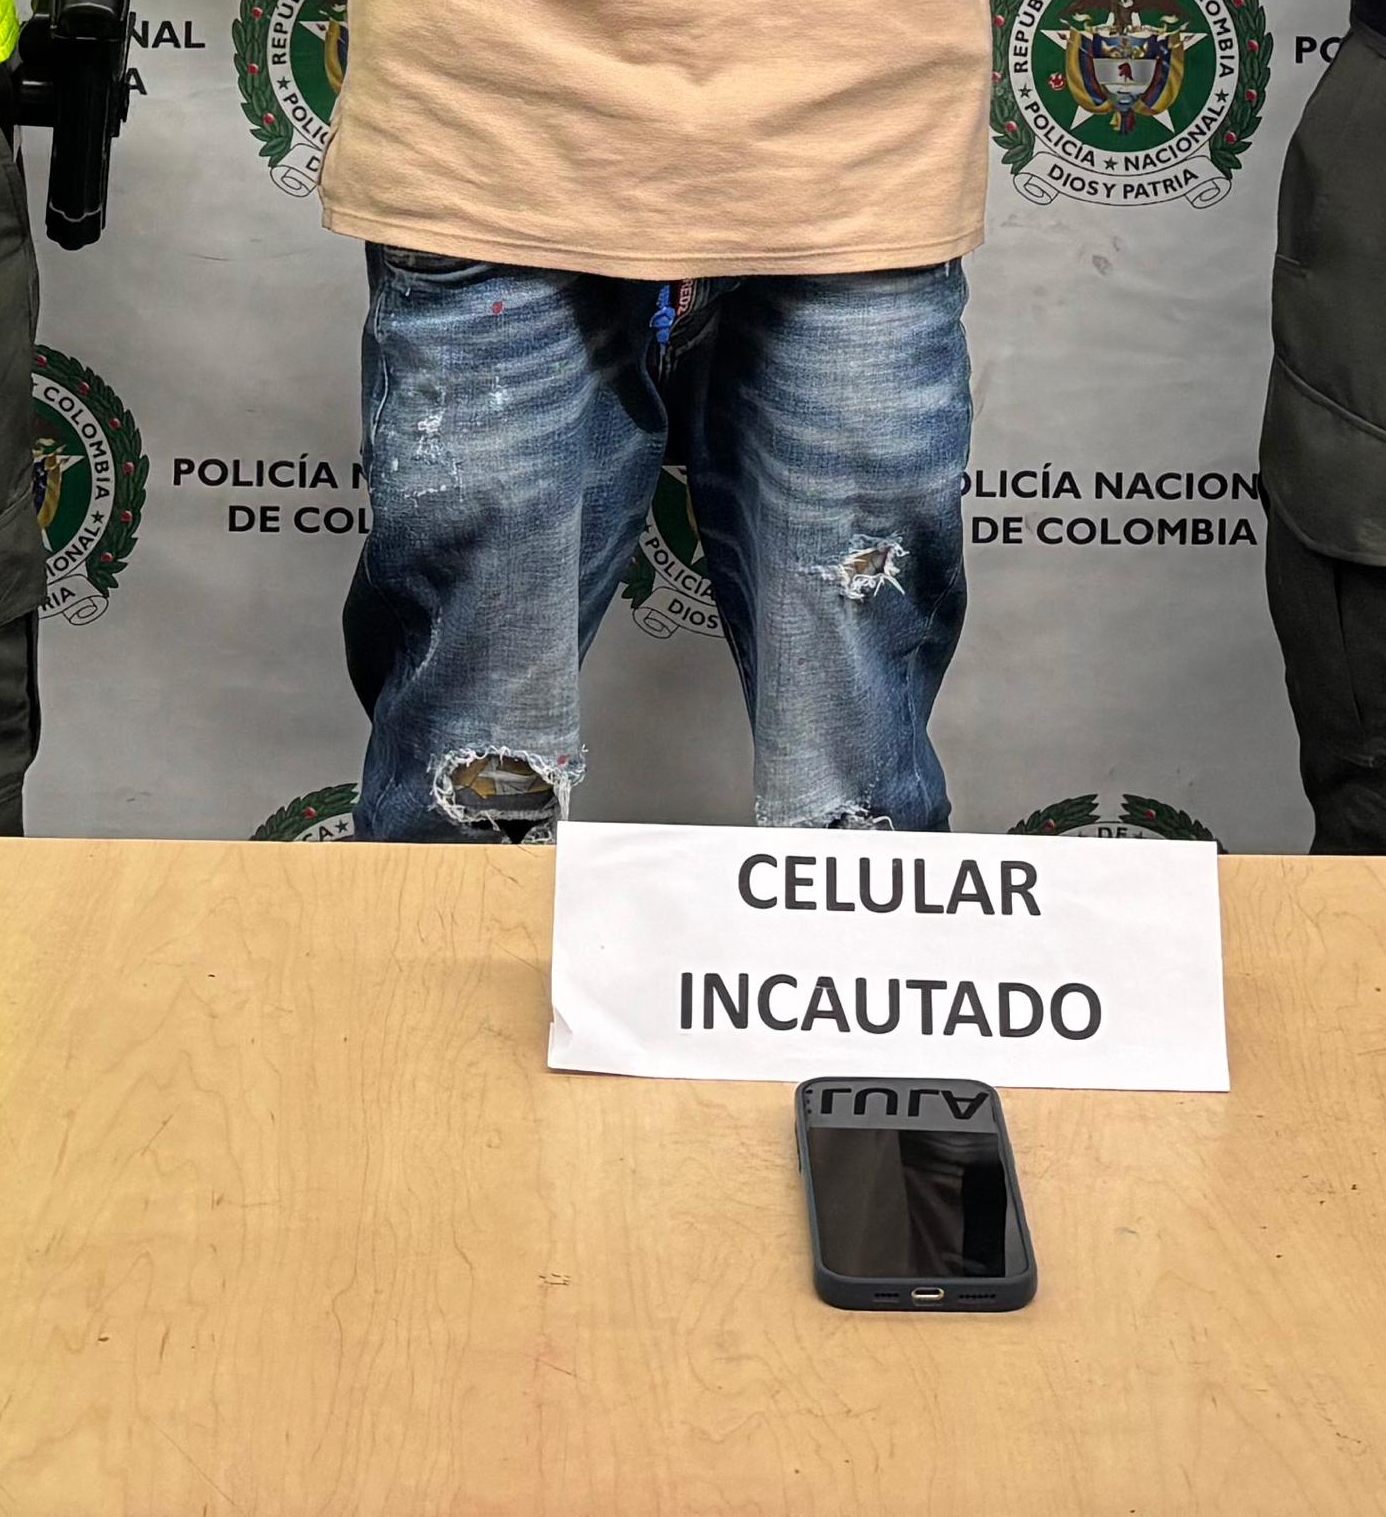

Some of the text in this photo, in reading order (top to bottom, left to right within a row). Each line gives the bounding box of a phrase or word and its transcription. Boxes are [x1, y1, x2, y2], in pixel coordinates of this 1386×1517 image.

[1124, 105, 1225, 171] NACIONAL
[1048, 164, 1099, 195] DIOS
[1123, 169, 1199, 199] PATRIA
[174, 453, 338, 489] POLICÍA
[961, 463, 1258, 500] LICÍA NACION
[229, 505, 280, 532] DE
[972, 517, 1257, 545] DE COLOMBIA
[738, 853, 1041, 916] CELULAR
[680, 972, 1102, 1040] INCAUTADO
